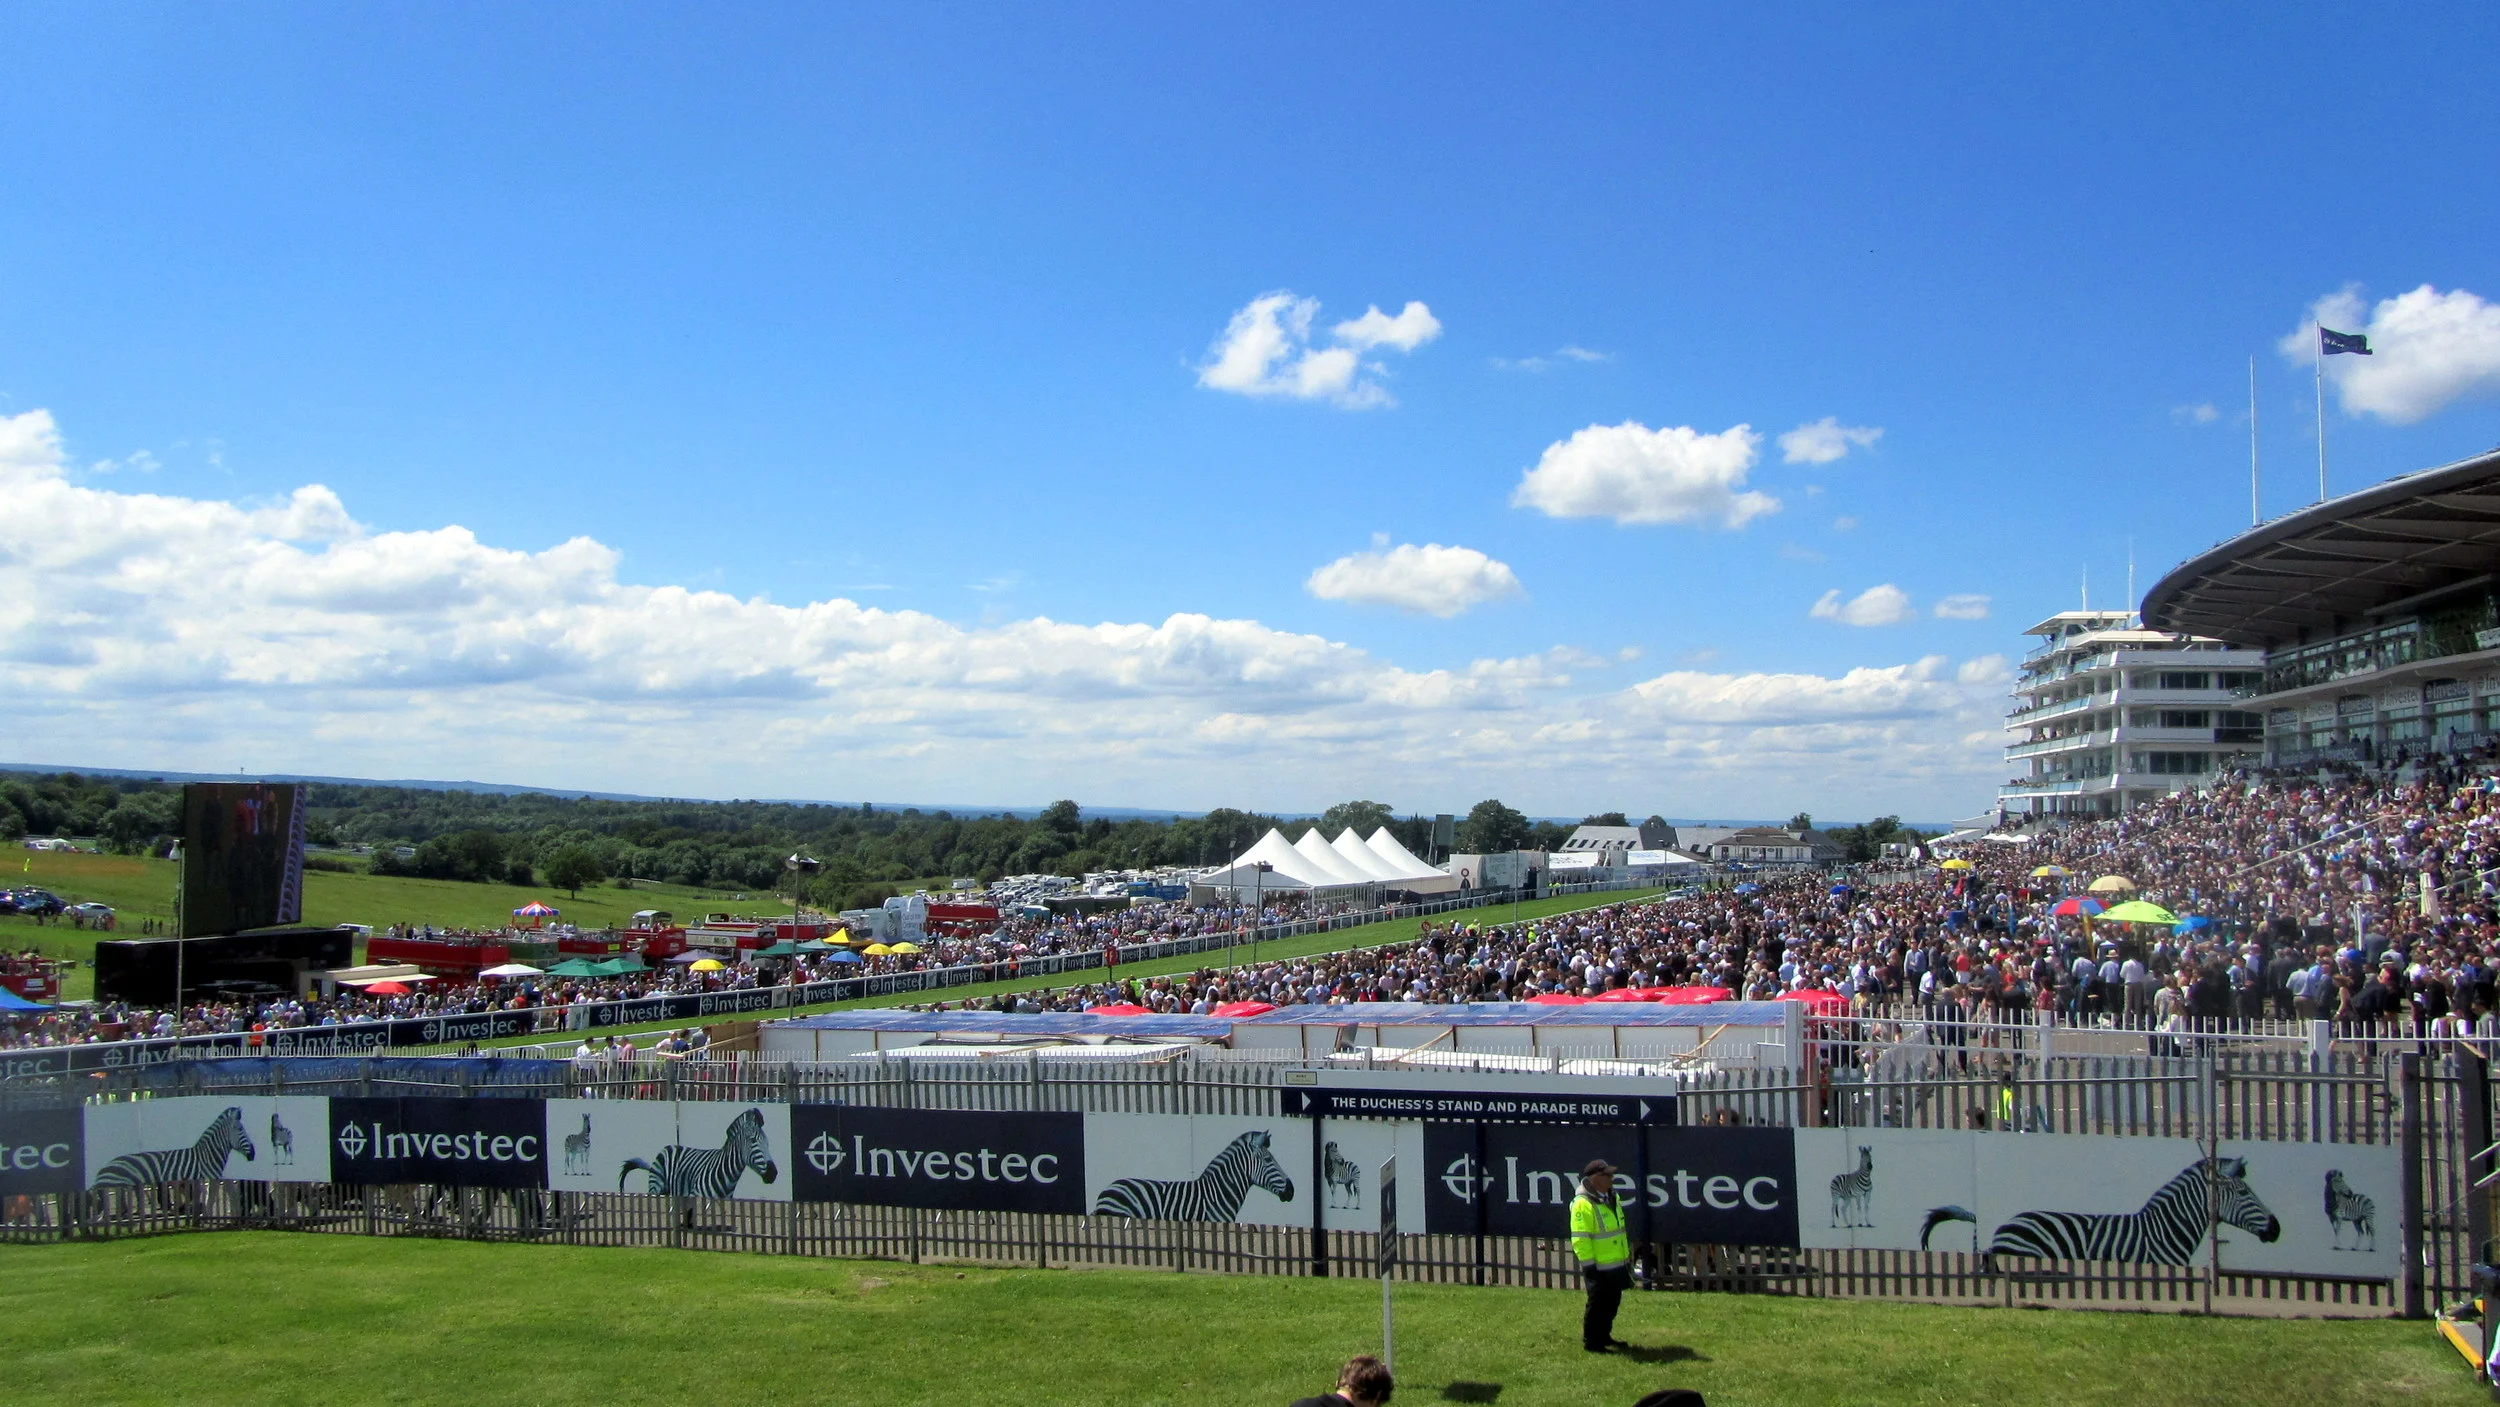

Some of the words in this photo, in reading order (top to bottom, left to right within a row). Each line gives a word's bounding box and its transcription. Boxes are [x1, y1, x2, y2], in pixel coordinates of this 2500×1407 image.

[714, 993, 769, 1011] Investec
[614, 1003, 676, 1023] Investec
[441, 1018, 517, 1040] Investec
[1331, 1097, 1356, 1108] THE
[1360, 1098, 1434, 1110] DUCHESS'S
[1437, 1100, 1483, 1112] STAND
[1487, 1101, 1517, 1113] AND
[1521, 1102, 1577, 1114] PARADE
[1581, 1103, 1619, 1116] RING
[372, 1122, 538, 1162] Investec
[853, 1135, 1059, 1184] Investec
